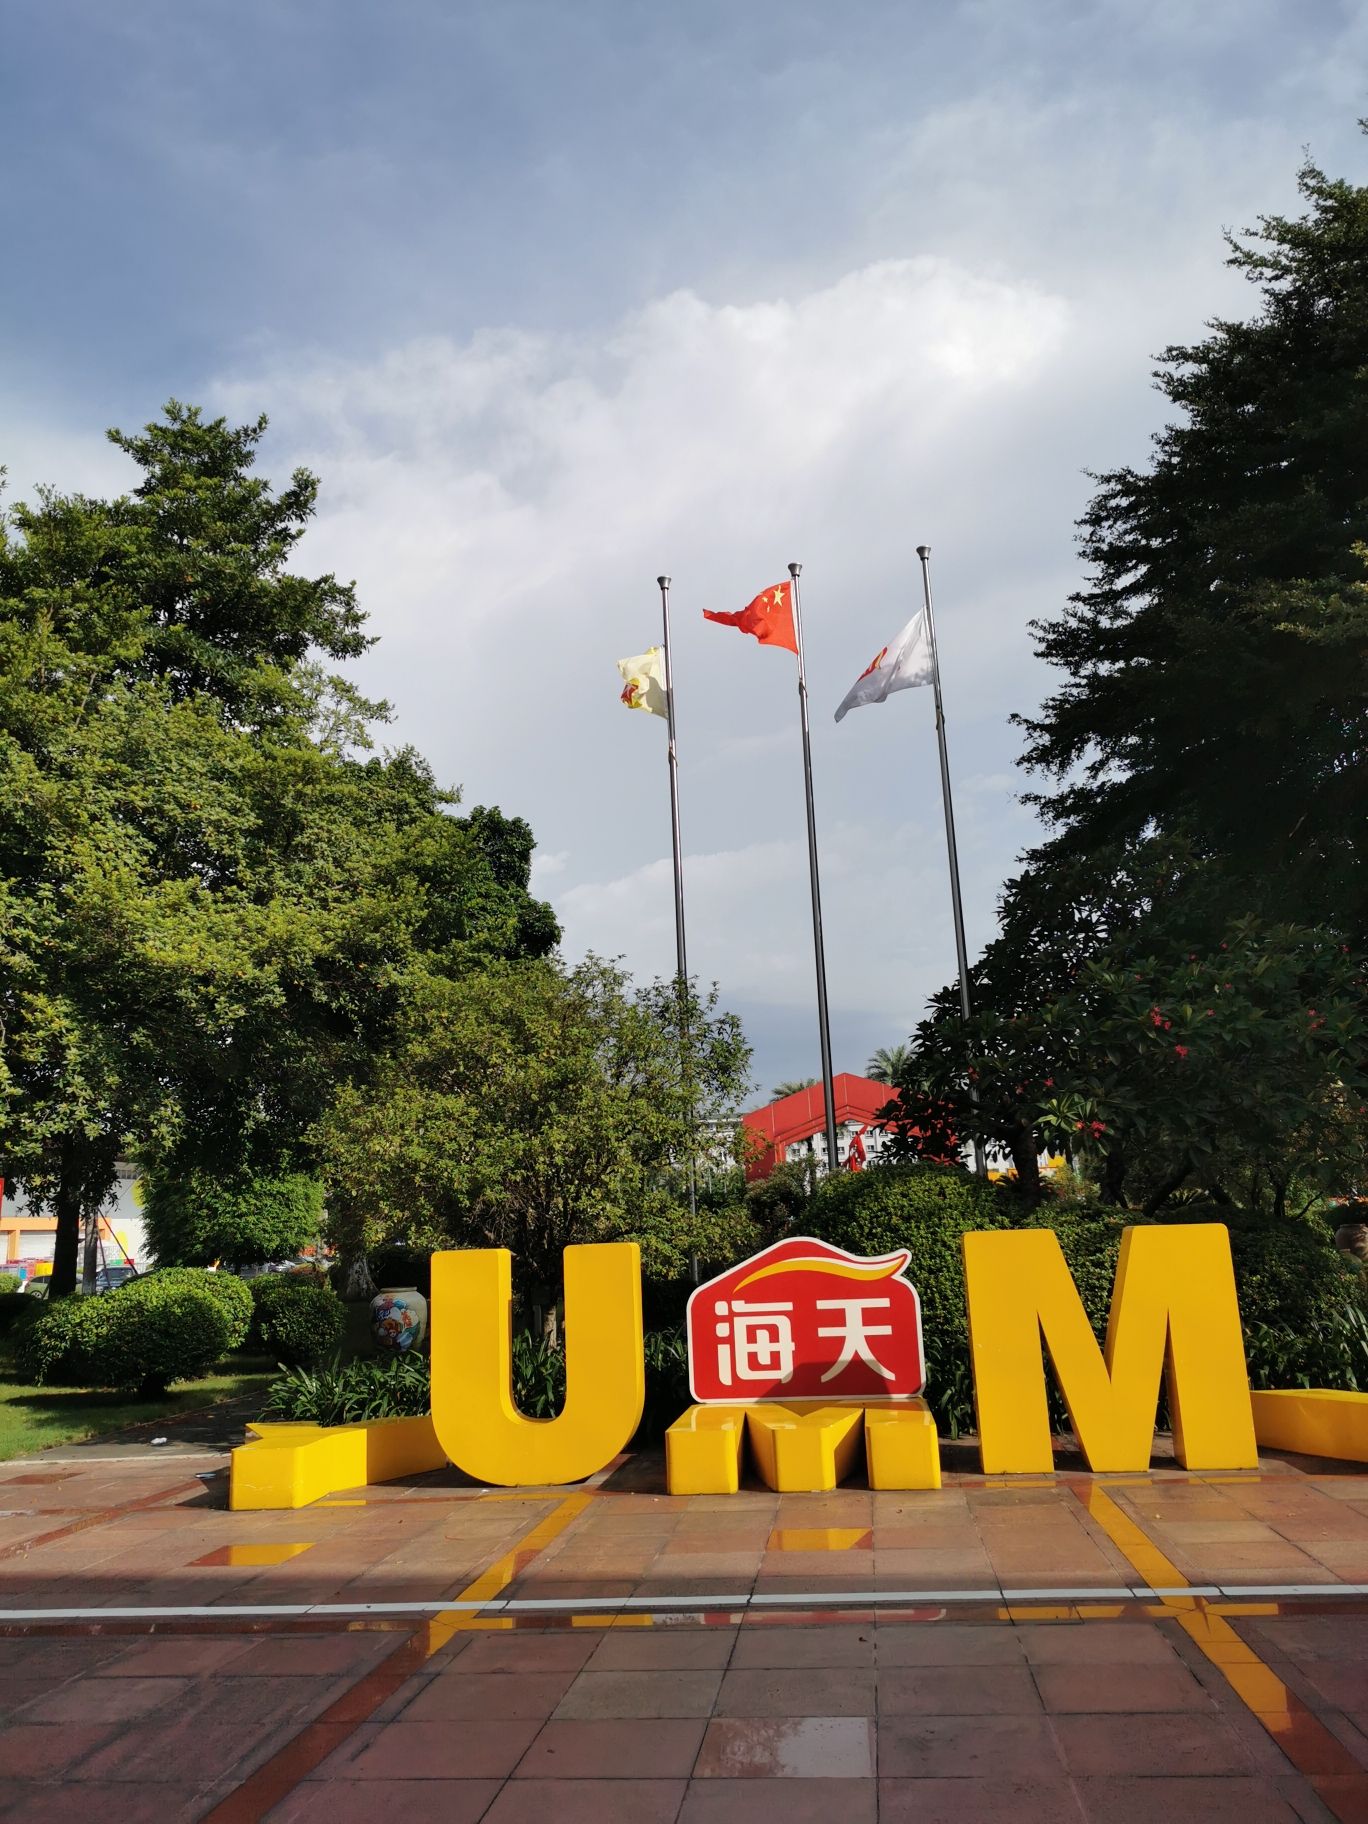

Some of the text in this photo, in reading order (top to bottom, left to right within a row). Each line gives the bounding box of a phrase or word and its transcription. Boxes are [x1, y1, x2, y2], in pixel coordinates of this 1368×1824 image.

[429, 1241, 646, 1487] U
[713, 1297, 897, 1386] 海天
[961, 1223, 1260, 1475] M
